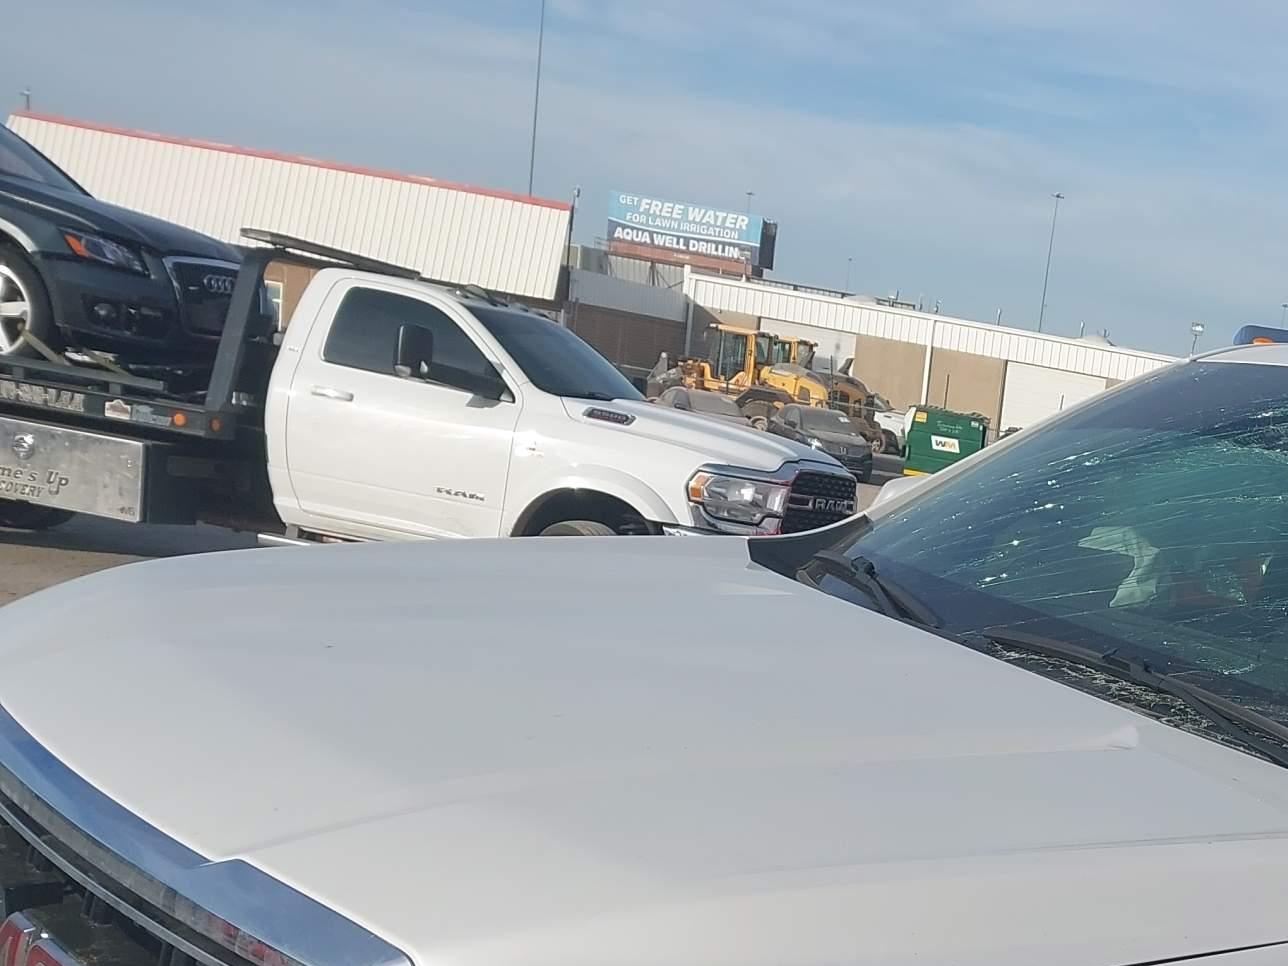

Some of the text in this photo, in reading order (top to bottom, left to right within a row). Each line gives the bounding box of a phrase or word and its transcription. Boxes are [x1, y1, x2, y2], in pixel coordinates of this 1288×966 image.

[619, 195, 749, 230] GET FREE WATER
[626, 212, 738, 240] FOR LAWN IRRIGATION
[614, 227, 747, 260] AQUA WELL DRILLIN
